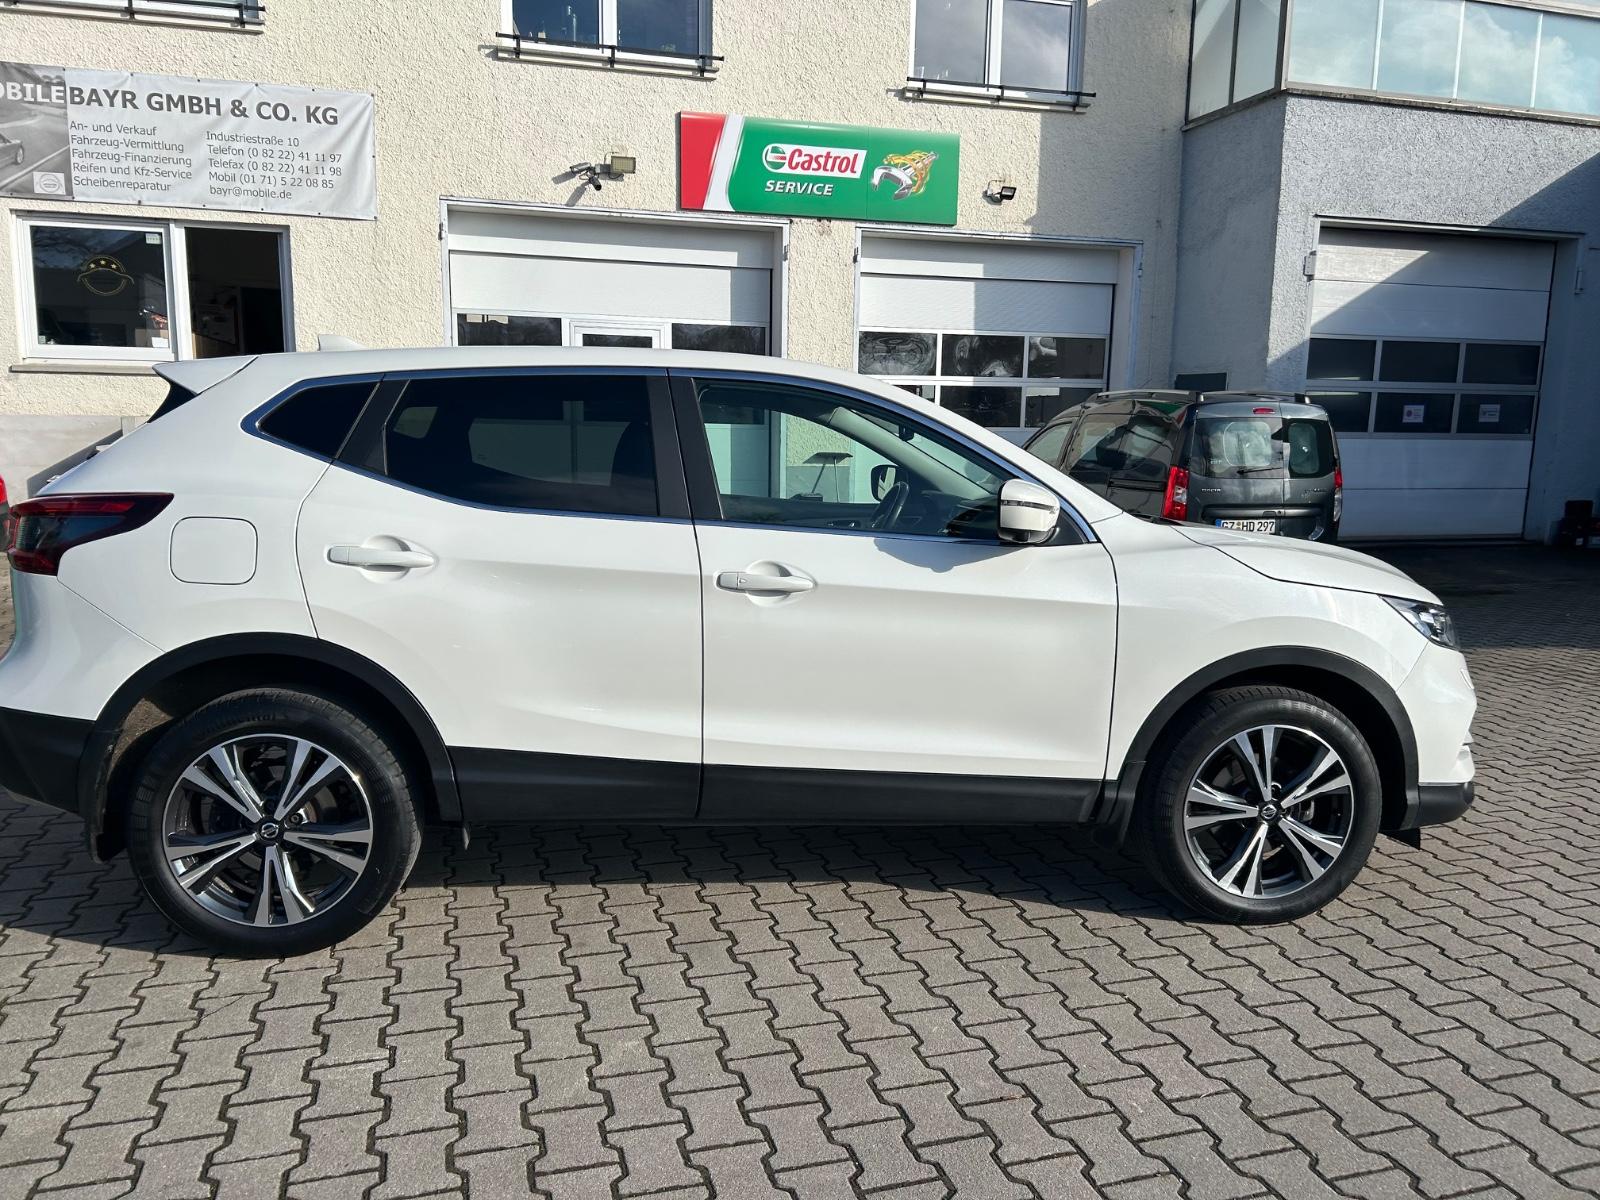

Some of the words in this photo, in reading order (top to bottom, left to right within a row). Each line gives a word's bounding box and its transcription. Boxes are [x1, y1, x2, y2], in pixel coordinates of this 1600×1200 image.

[0, 82, 65, 103] BILE
[69, 86, 139, 109] BAYR
[146, 93, 222, 117] GMBH
[230, 99, 249, 118] &
[256, 101, 297, 122] CO.
[305, 105, 338, 125] KG
[70, 121, 88, 130] An-
[92, 123, 112, 133] und
[116, 124, 157, 136] Verkauf
[71, 135, 184, 153] Fahrzeug-Vermittlung
[206, 131, 284, 146] Industriestraße
[287, 137, 300, 147] 10
[72, 148, 192, 167] Fahrzeug-Finanzierung
[207, 144, 244, 156] Telefon
[247, 147, 259, 158] (0
[262, 149, 274, 159] 82
[279, 150, 295, 161] 22)
[298, 152, 310, 161] 41
[315, 153, 325, 162] 11
[329, 154, 342, 164] 97
[787, 148, 859, 174] Castrol
[73, 162, 106, 174] Reifen
[110, 166, 130, 175] und
[134, 166, 192, 179] Kfz-Service
[208, 158, 244, 170] Telefax
[247, 161, 259, 172] (0
[261, 162, 274, 172] 82
[279, 163, 295, 175] 22)
[298, 165, 310, 175] 41
[315, 166, 325, 176] 11
[329, 167, 342, 177] 98
[73, 176, 171, 191] Scheibenreparatur
[208, 171, 236, 183] Mobil
[240, 174, 256, 185] (01
[261, 175, 277, 187] 71)
[281, 177, 287, 186] 5
[290, 177, 303, 187] 22
[306, 178, 318, 188] 08
[321, 179, 334, 189] 85
[764, 180, 834, 196] SERVICE
[209, 185, 292, 199] bayr@mobile.de
[1242, 521, 1255, 532] HD
[1257, 521, 1275, 532] 297
